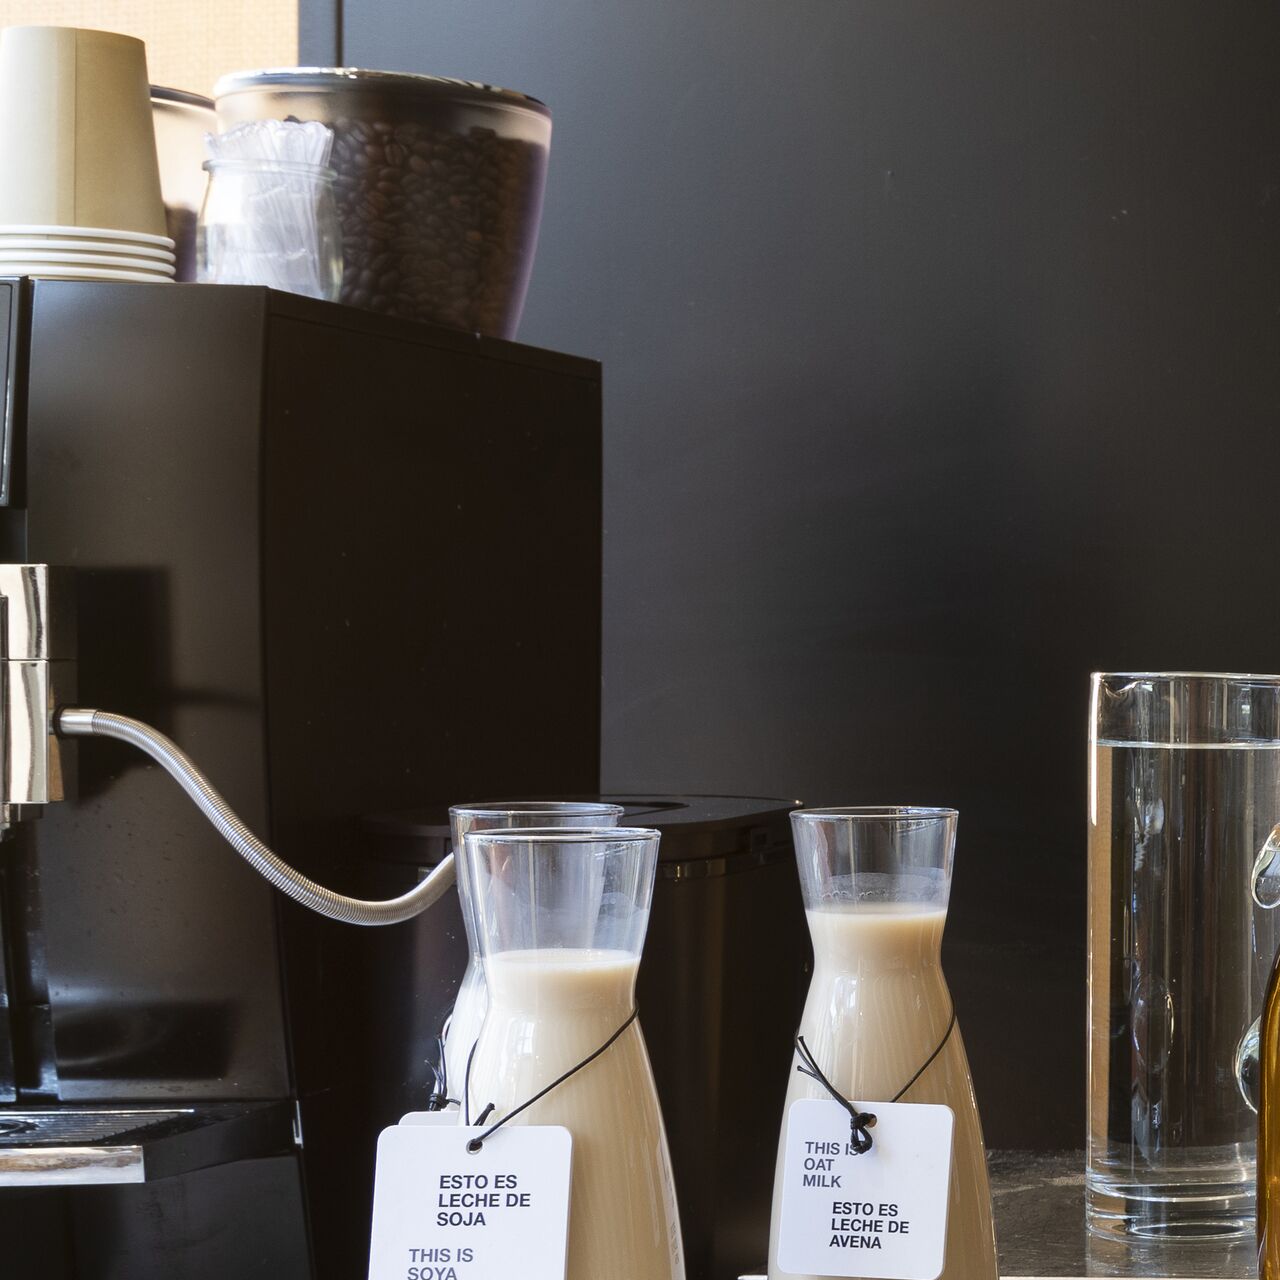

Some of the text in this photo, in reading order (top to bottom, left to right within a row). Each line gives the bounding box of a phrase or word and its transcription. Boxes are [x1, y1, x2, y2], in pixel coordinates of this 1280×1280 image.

[805, 1141, 840, 1155] THIS
[804, 1157, 835, 1171] OAT
[440, 1174, 517, 1189] ESTO ES
[803, 1174, 841, 1188] MILK
[438, 1193, 531, 1208] LECHE DE
[832, 1202, 898, 1217] ESTO ES
[437, 1212, 486, 1226] SOJA
[831, 1218, 909, 1234] LECHE DE
[829, 1235, 881, 1249] AVENA
[409, 1248, 473, 1263] THIS IS
[407, 1267, 457, 1280] SOYA
